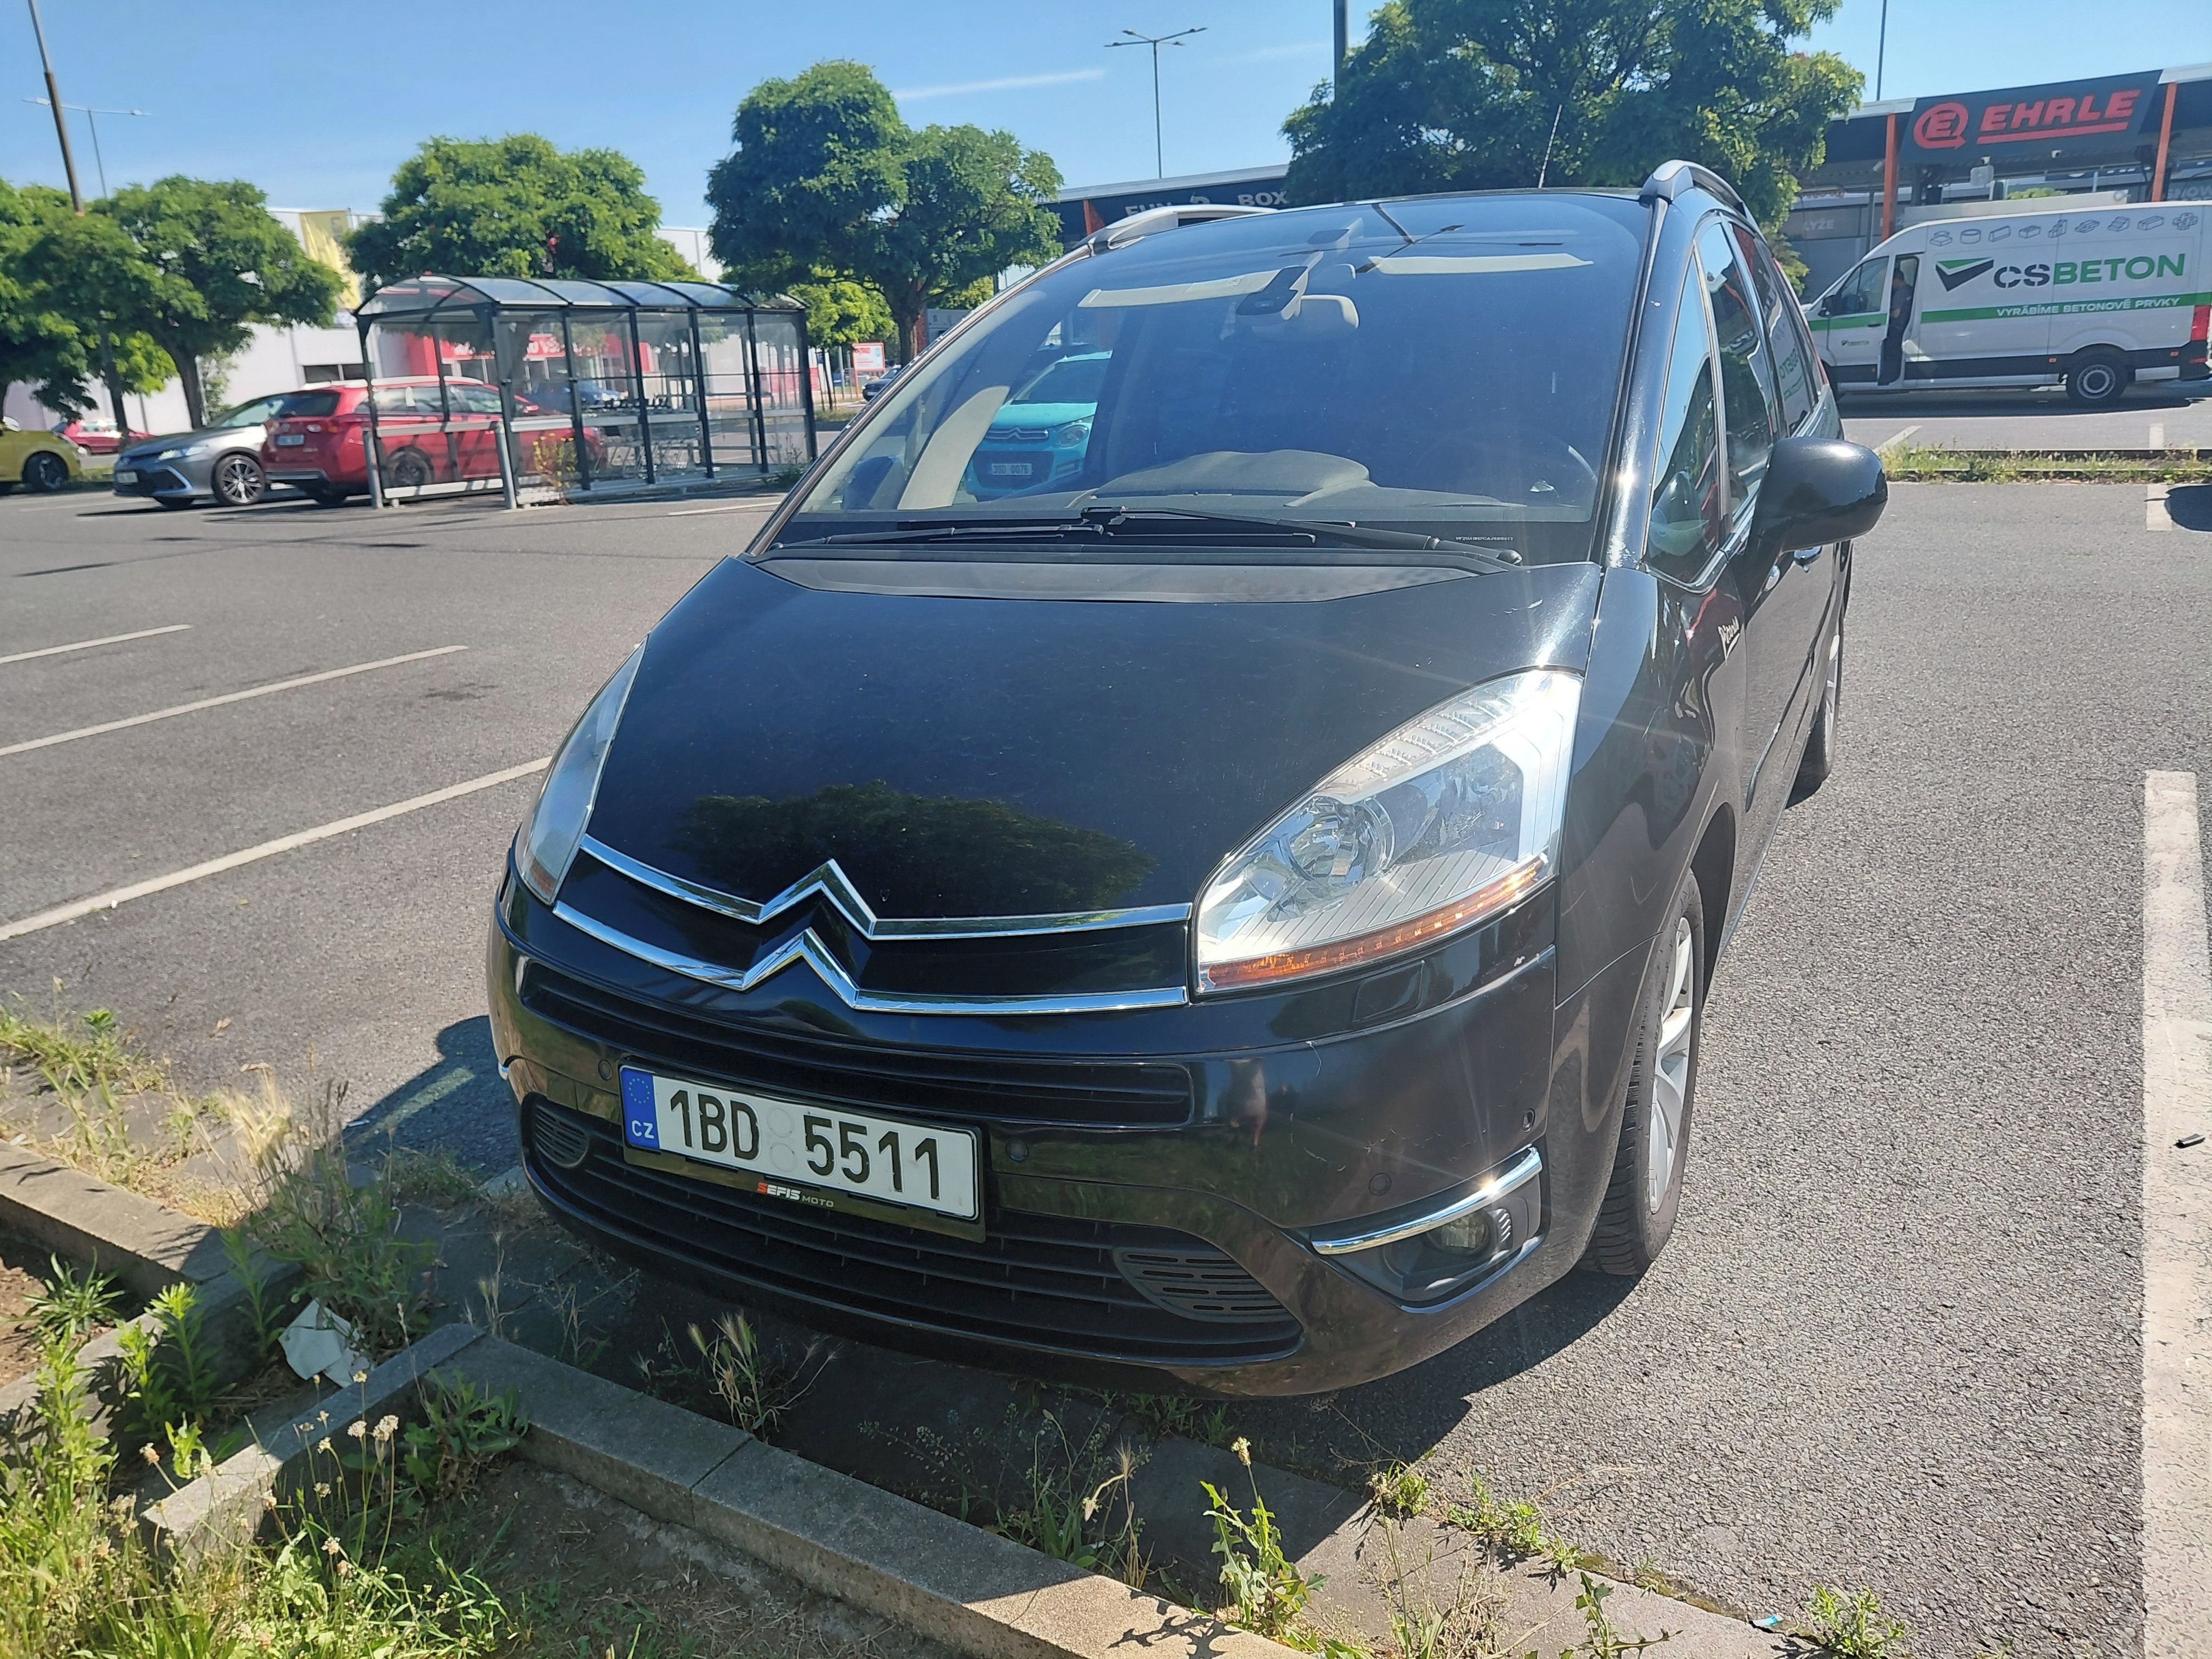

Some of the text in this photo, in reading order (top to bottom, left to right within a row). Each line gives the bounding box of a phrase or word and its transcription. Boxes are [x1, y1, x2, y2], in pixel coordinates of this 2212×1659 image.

[1979, 89, 2142, 132] EHRLE
[1237, 190, 1288, 206] BOX
[1993, 253, 2185, 288] CSBETON
[1997, 298, 2181, 317] VYRÁBÍME BETONOVÉ PRVKY
[631, 1120, 655, 1140] CZ
[670, 1089, 940, 1200] 1BD 5511
[756, 1181, 834, 1208] SEFIS MOTO
